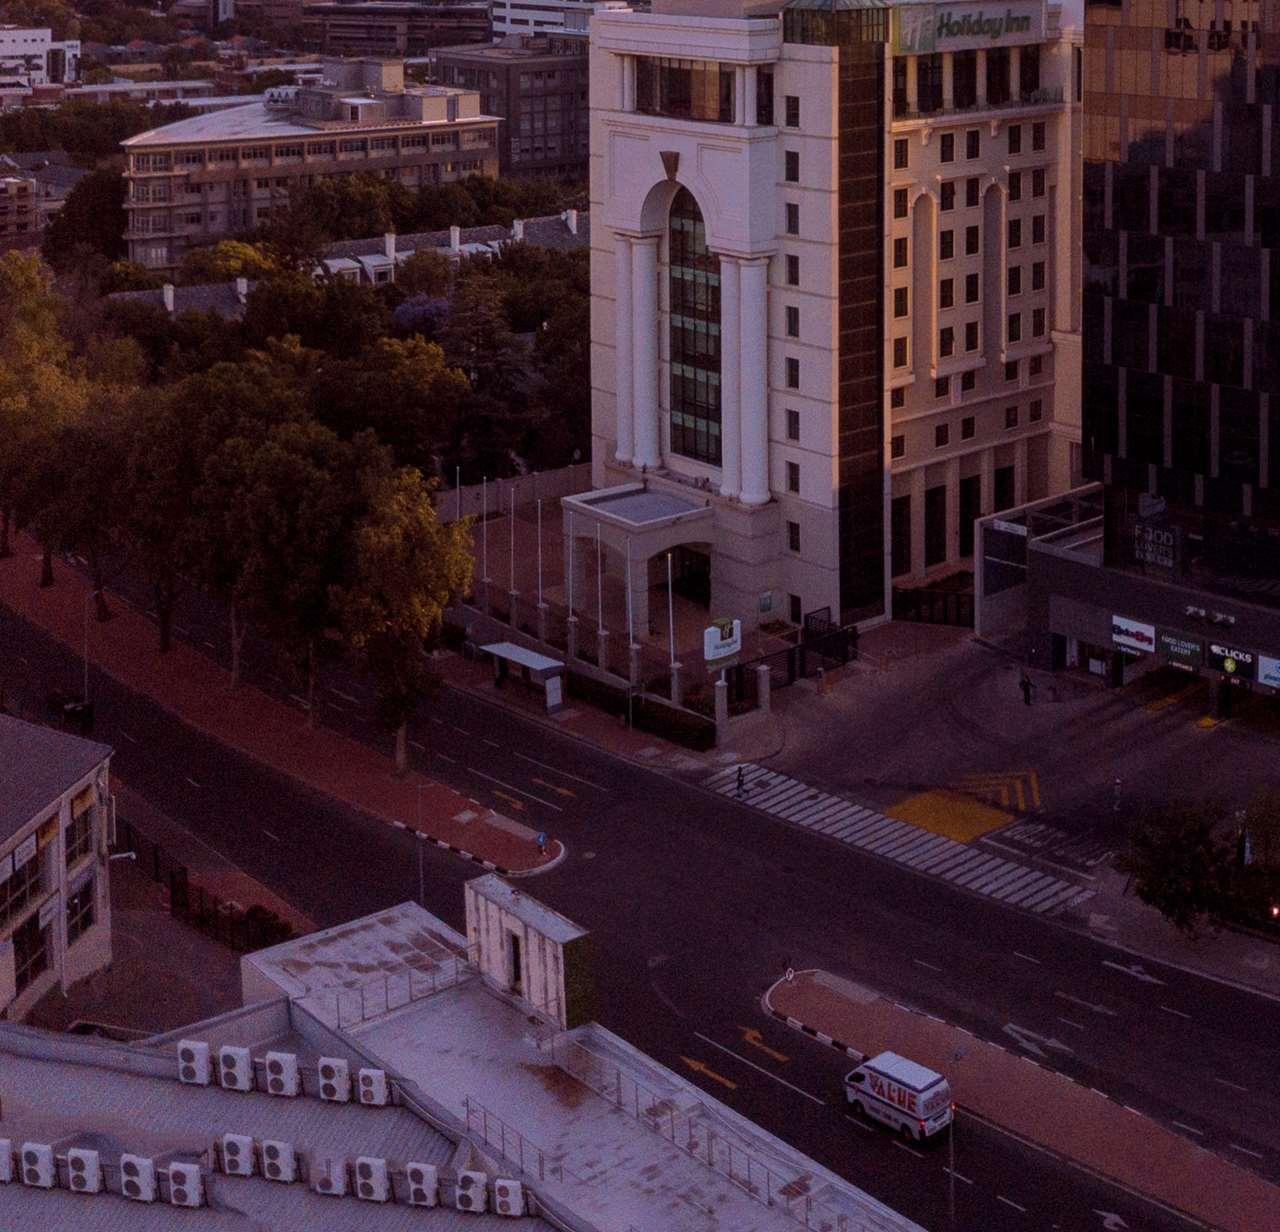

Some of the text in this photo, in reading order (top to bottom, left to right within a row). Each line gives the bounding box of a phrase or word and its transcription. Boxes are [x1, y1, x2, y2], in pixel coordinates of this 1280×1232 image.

[937, 9, 1031, 39] Holiday Inn
[1220, 647, 1252, 663] CLICKS
